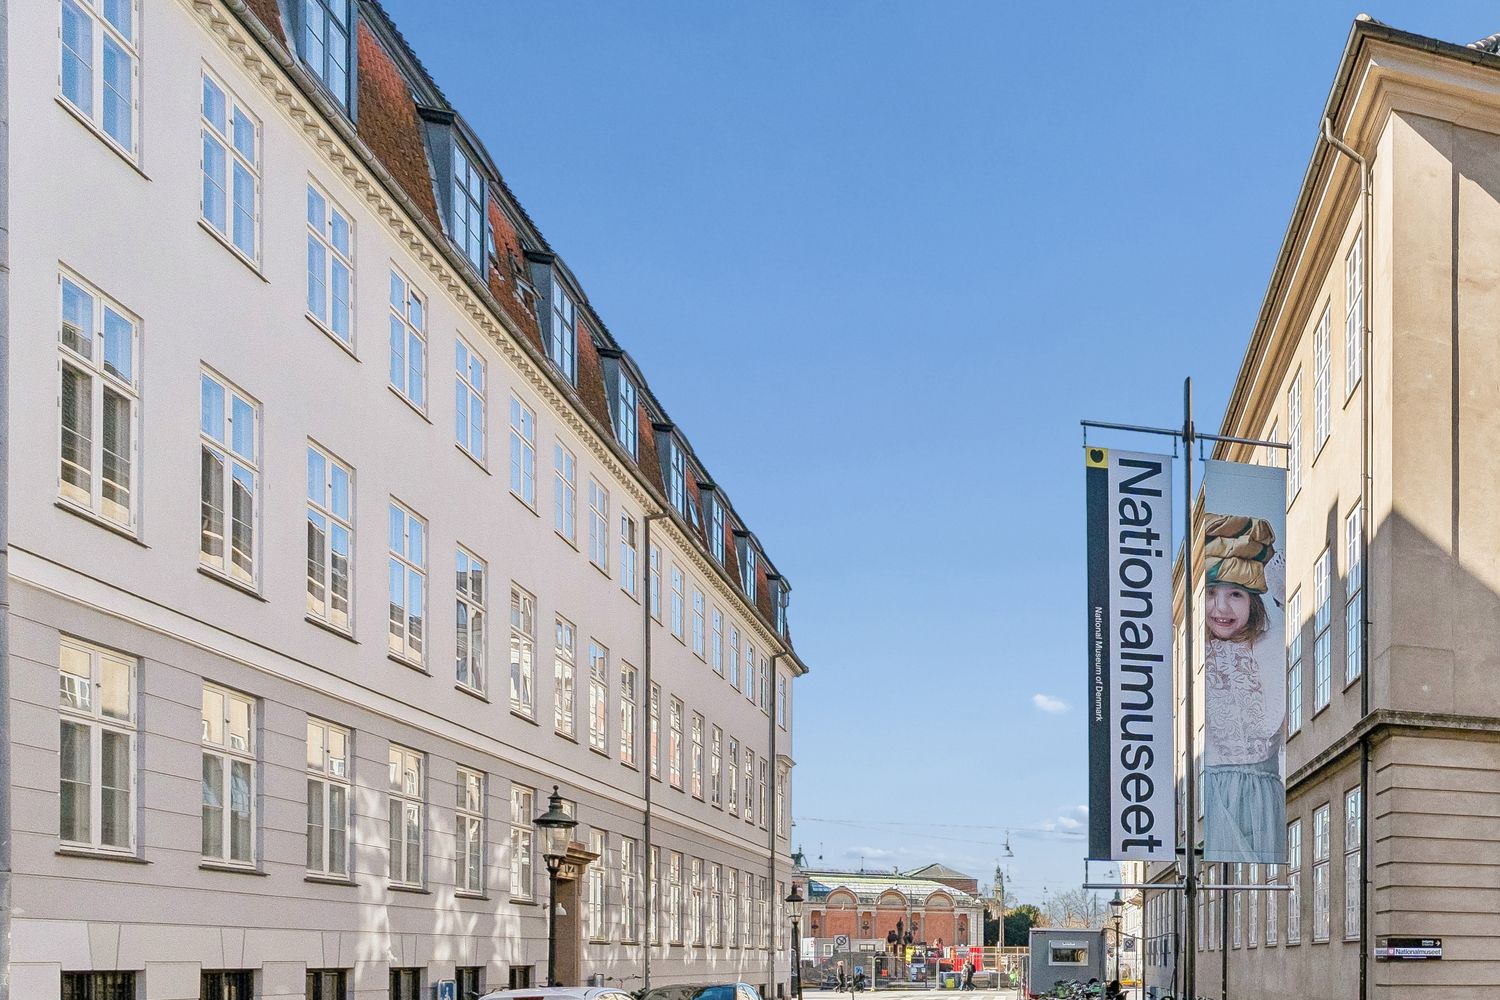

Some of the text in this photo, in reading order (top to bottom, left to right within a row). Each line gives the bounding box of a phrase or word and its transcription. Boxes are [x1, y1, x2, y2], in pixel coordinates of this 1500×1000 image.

[1094, 606, 1104, 722] National Museum of Denmark
[1118, 458, 1163, 853] Nationalmuseet
